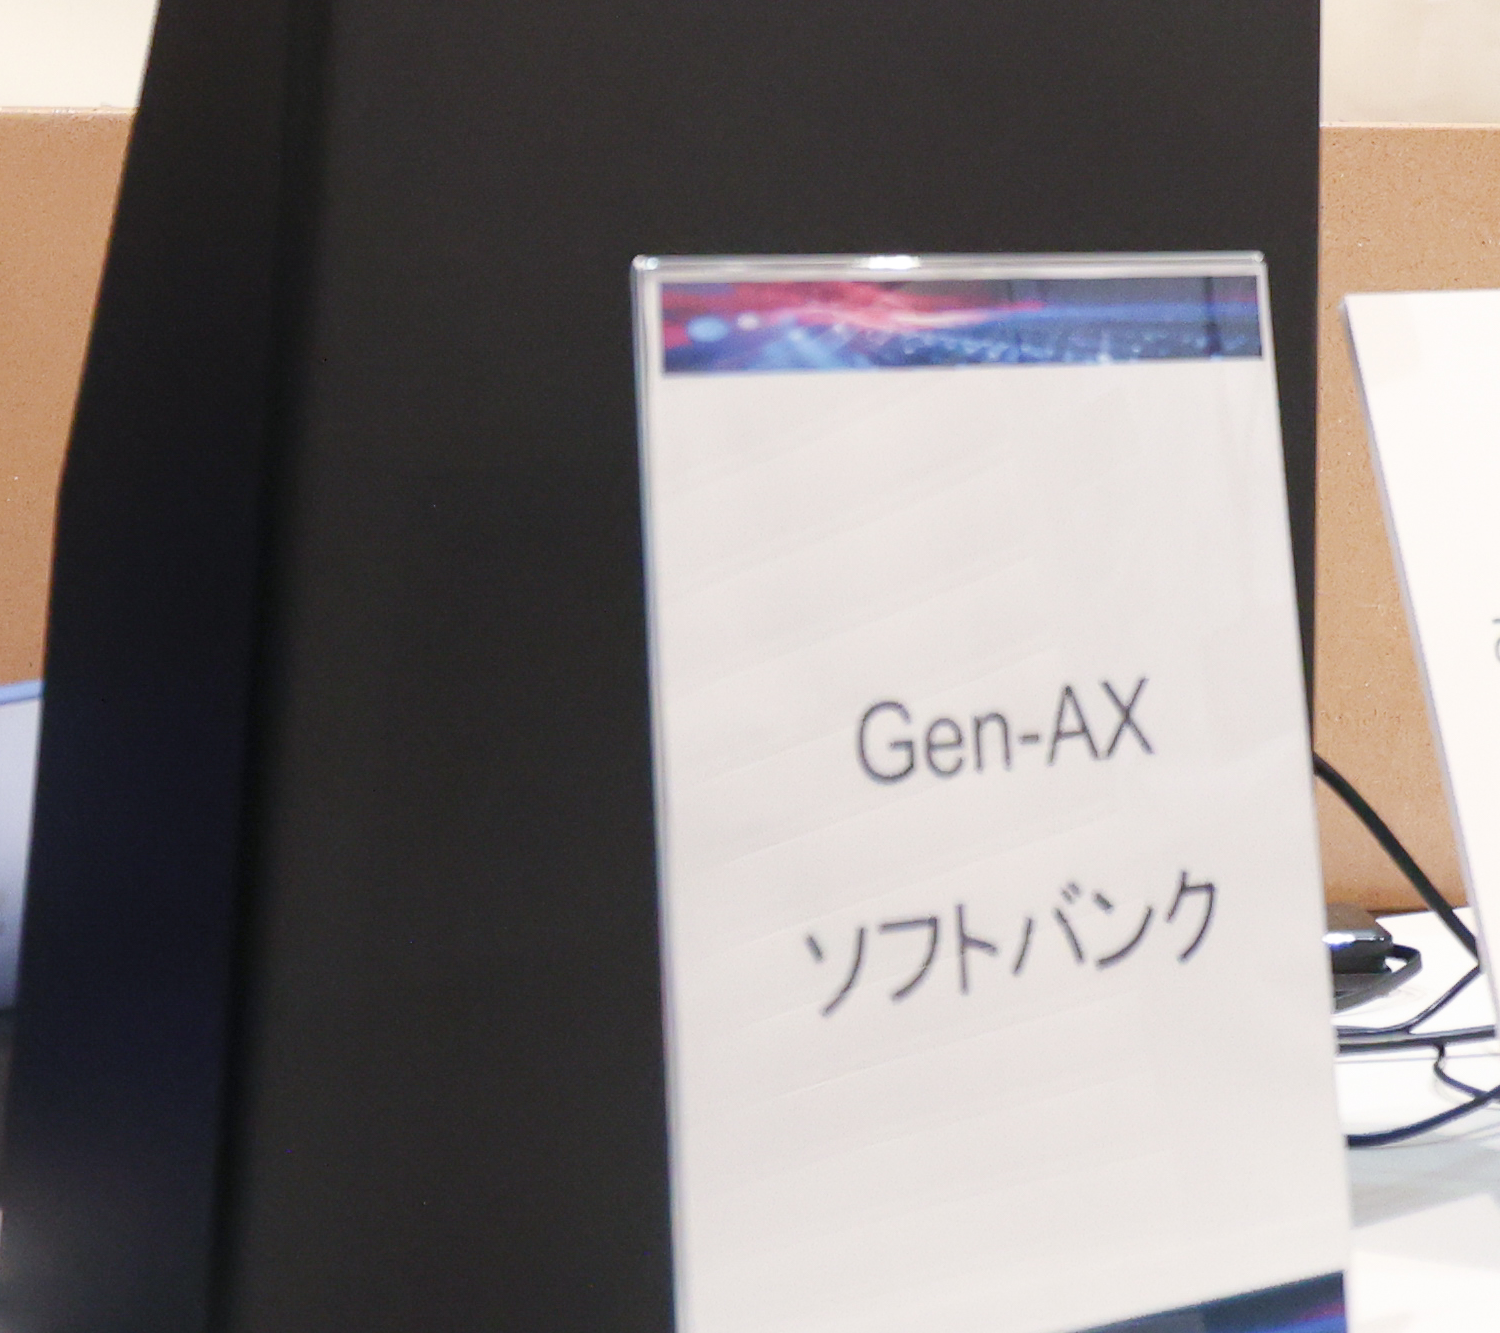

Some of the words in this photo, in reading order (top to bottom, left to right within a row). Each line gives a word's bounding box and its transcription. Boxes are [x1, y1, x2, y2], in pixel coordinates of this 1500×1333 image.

[855, 676, 1157, 785] Gen-AX
[804, 868, 1218, 1017] ソフトバンク
